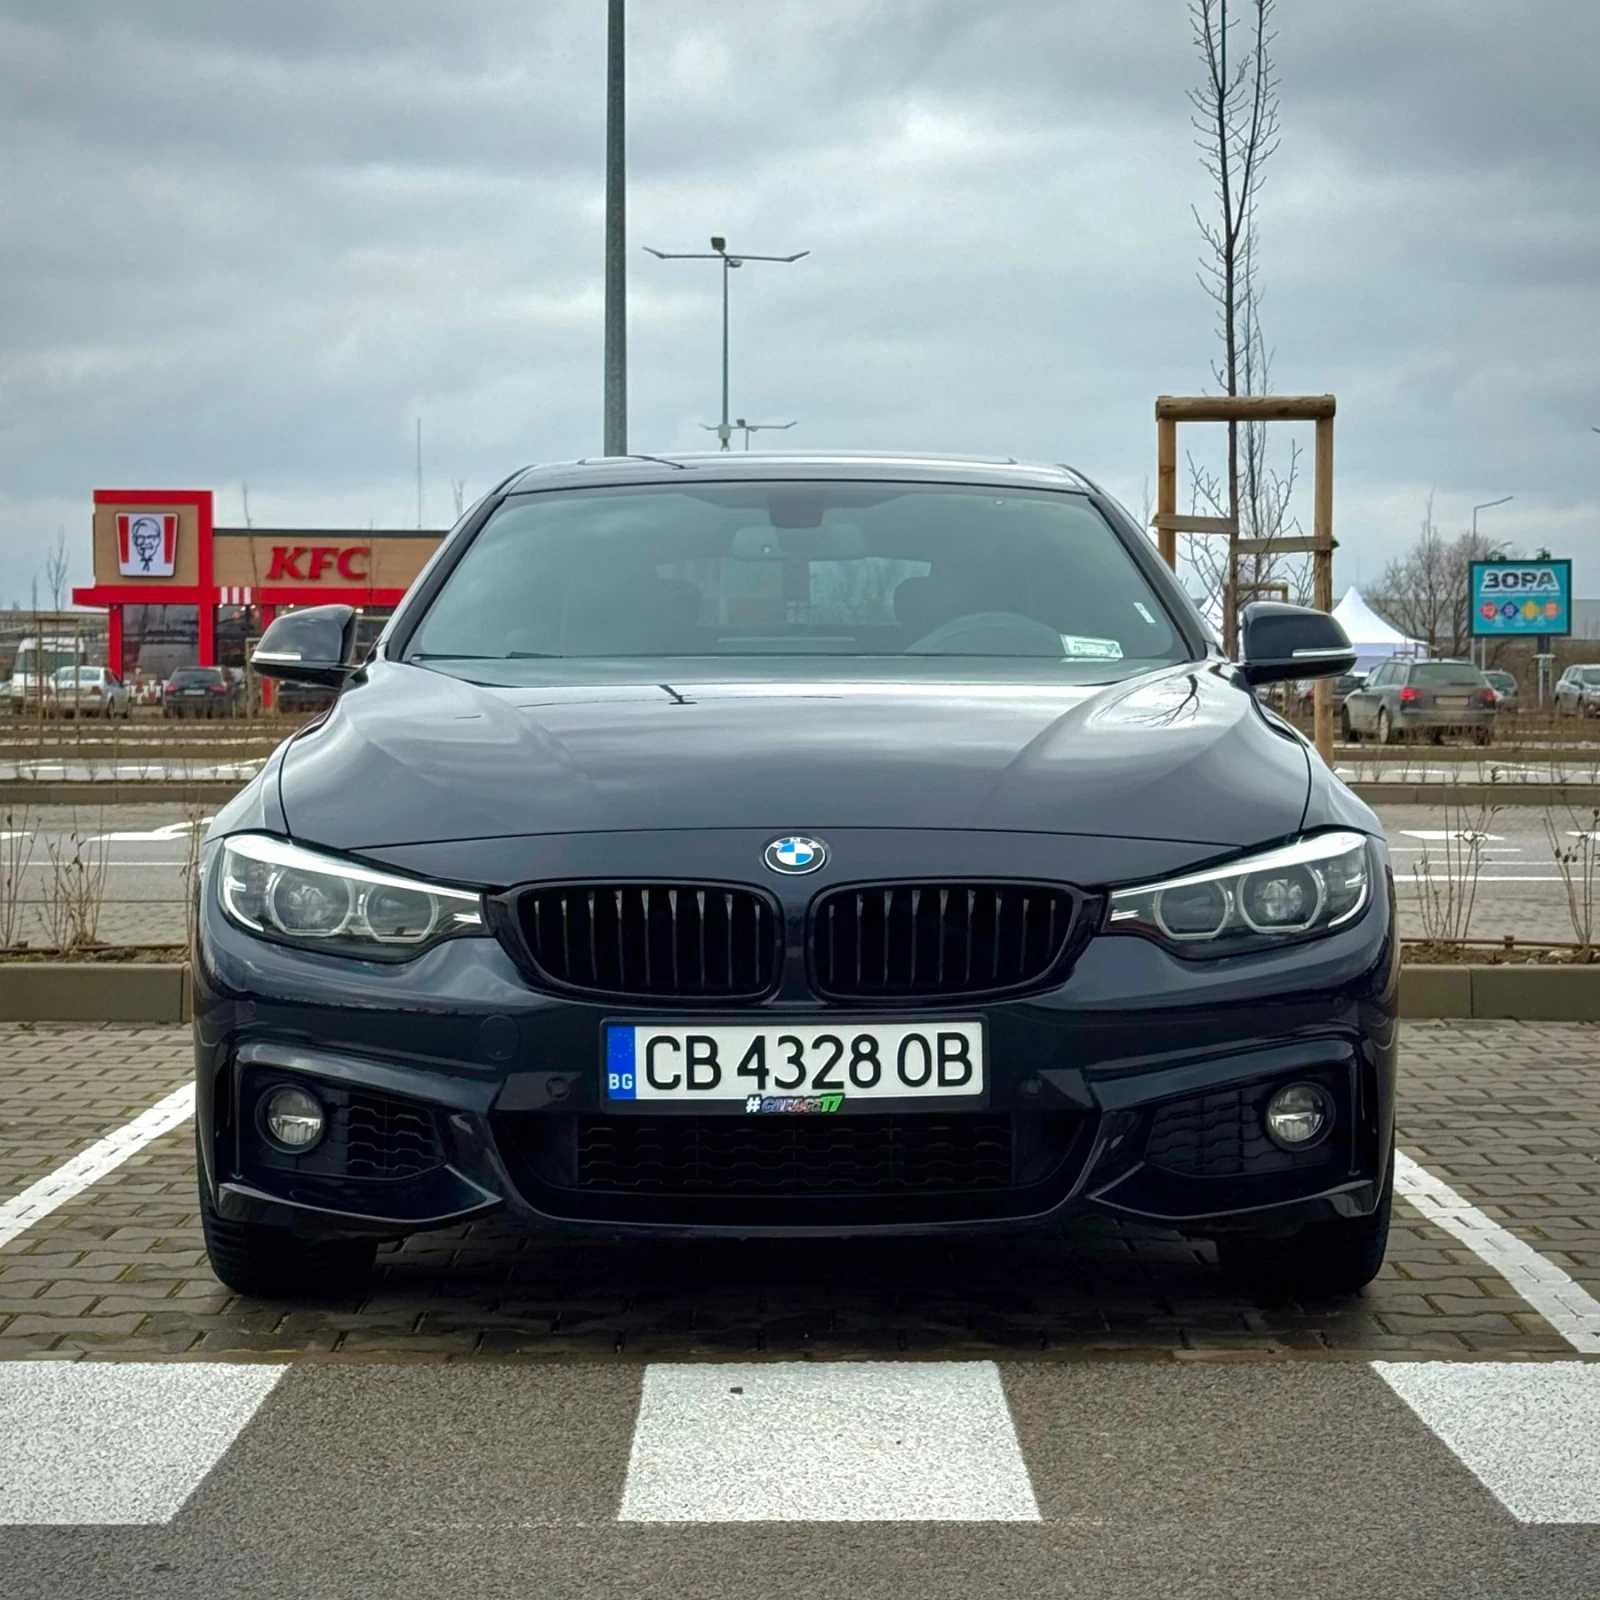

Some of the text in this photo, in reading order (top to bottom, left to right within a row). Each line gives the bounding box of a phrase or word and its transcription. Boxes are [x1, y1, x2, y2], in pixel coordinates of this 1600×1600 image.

[266, 546, 370, 580] KFC
[1483, 571, 1557, 590] ЗОРА
[645, 1034, 722, 1091] CB
[736, 1033, 882, 1090] 4328
[608, 1073, 633, 1091] BG
